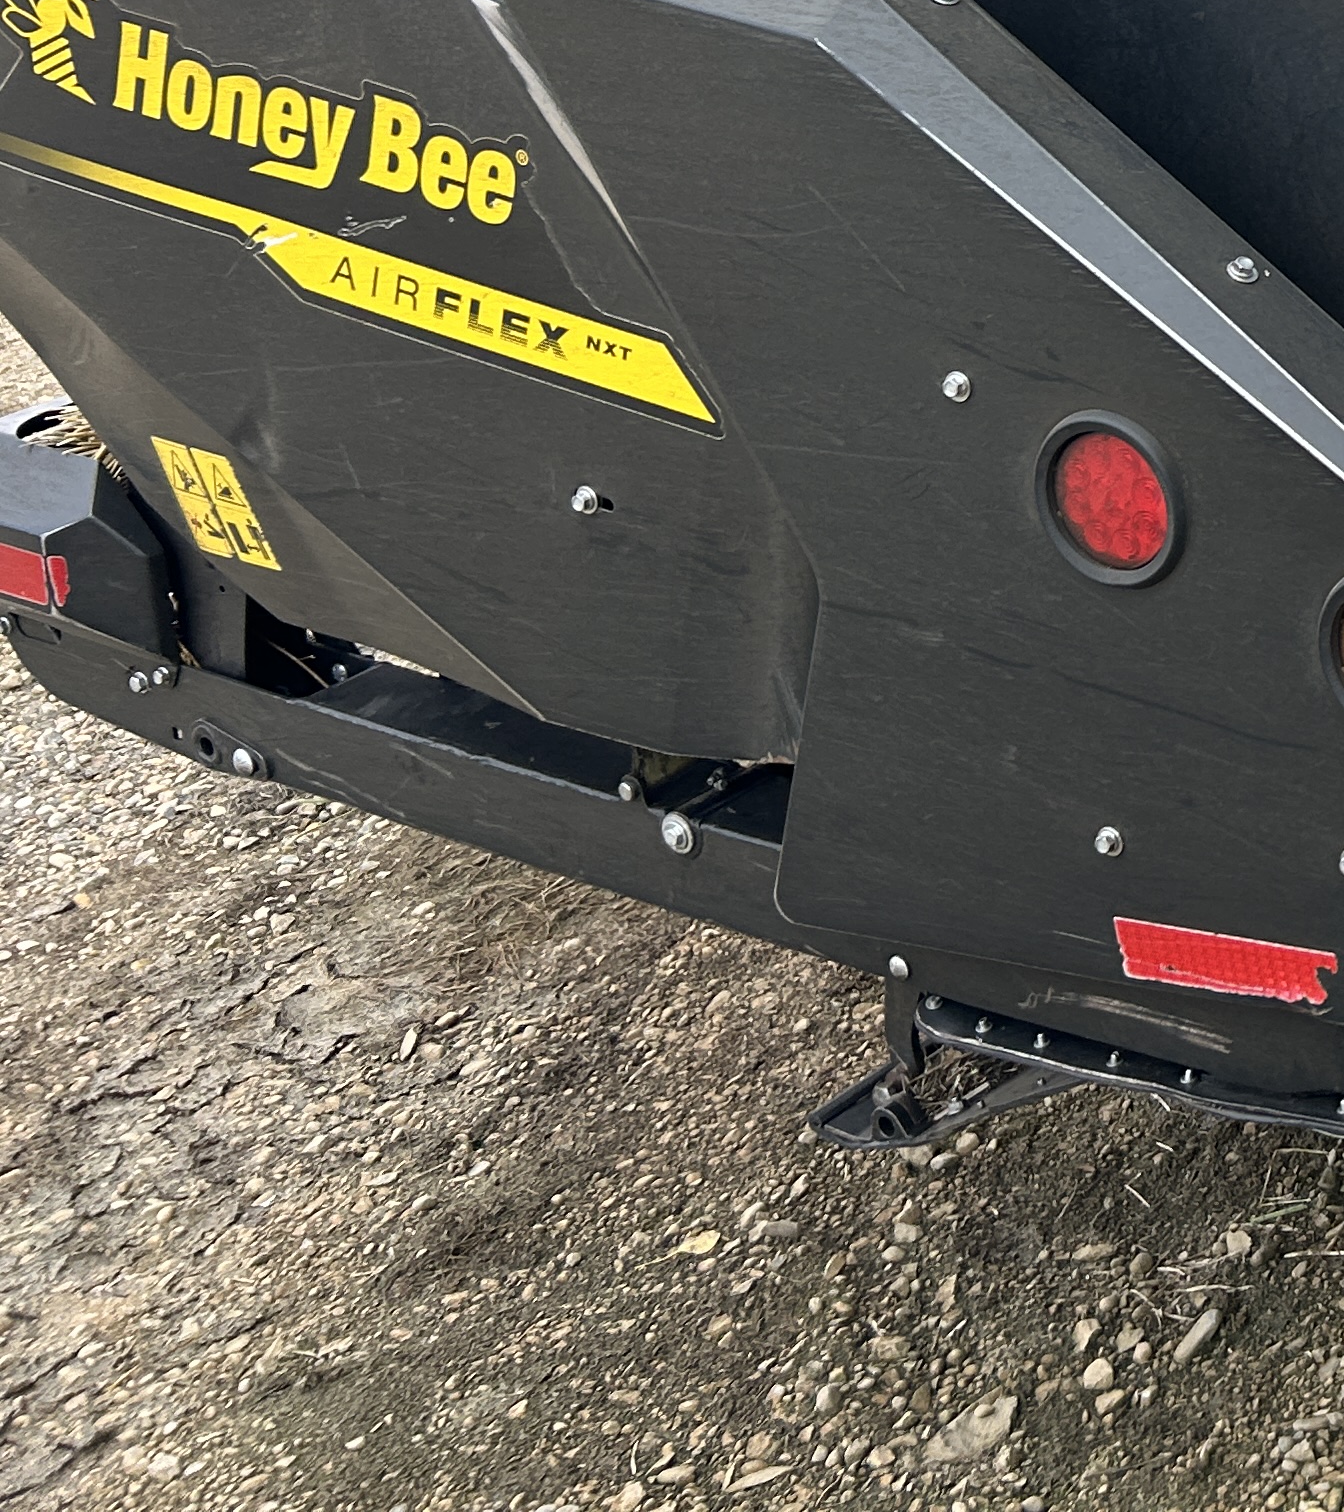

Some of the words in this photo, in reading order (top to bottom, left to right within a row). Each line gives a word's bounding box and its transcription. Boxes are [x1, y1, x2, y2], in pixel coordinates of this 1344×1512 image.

[112, 20, 356, 190] Honey
[359, 94, 517, 225] Bee
[329, 256, 569, 362] AIRFLEX
[586, 335, 632, 361] NXT
